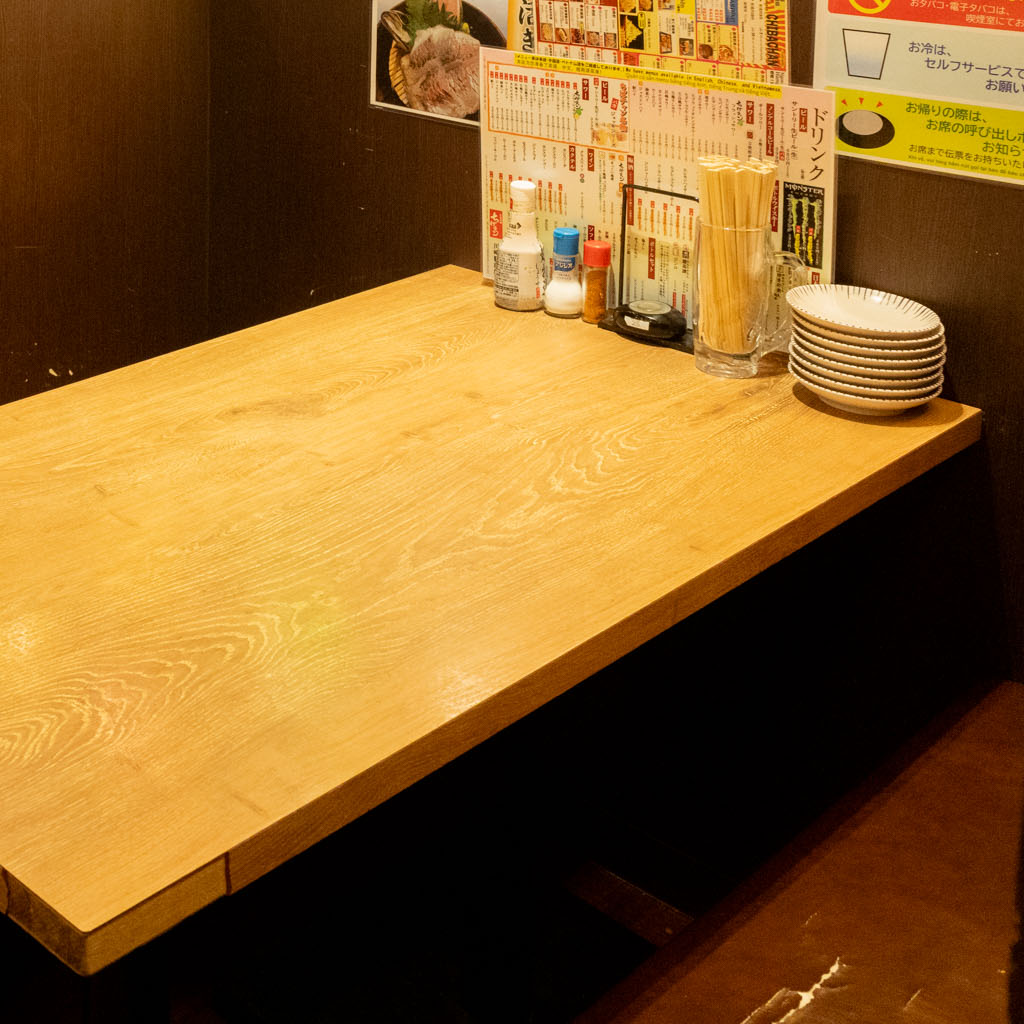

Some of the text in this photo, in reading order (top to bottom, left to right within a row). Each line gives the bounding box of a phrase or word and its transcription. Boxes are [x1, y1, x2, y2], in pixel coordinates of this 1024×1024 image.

[908, 41, 952, 57] お冷は、
[905, 102, 988, 124] お帰りの際は、
[809, 108, 828, 181] ドリンク
[982, 141, 1024, 157] お知ら
[908, 144, 1024, 169] お席まで伝票をお持ちいた
[784, 182, 824, 195] MONSTER
